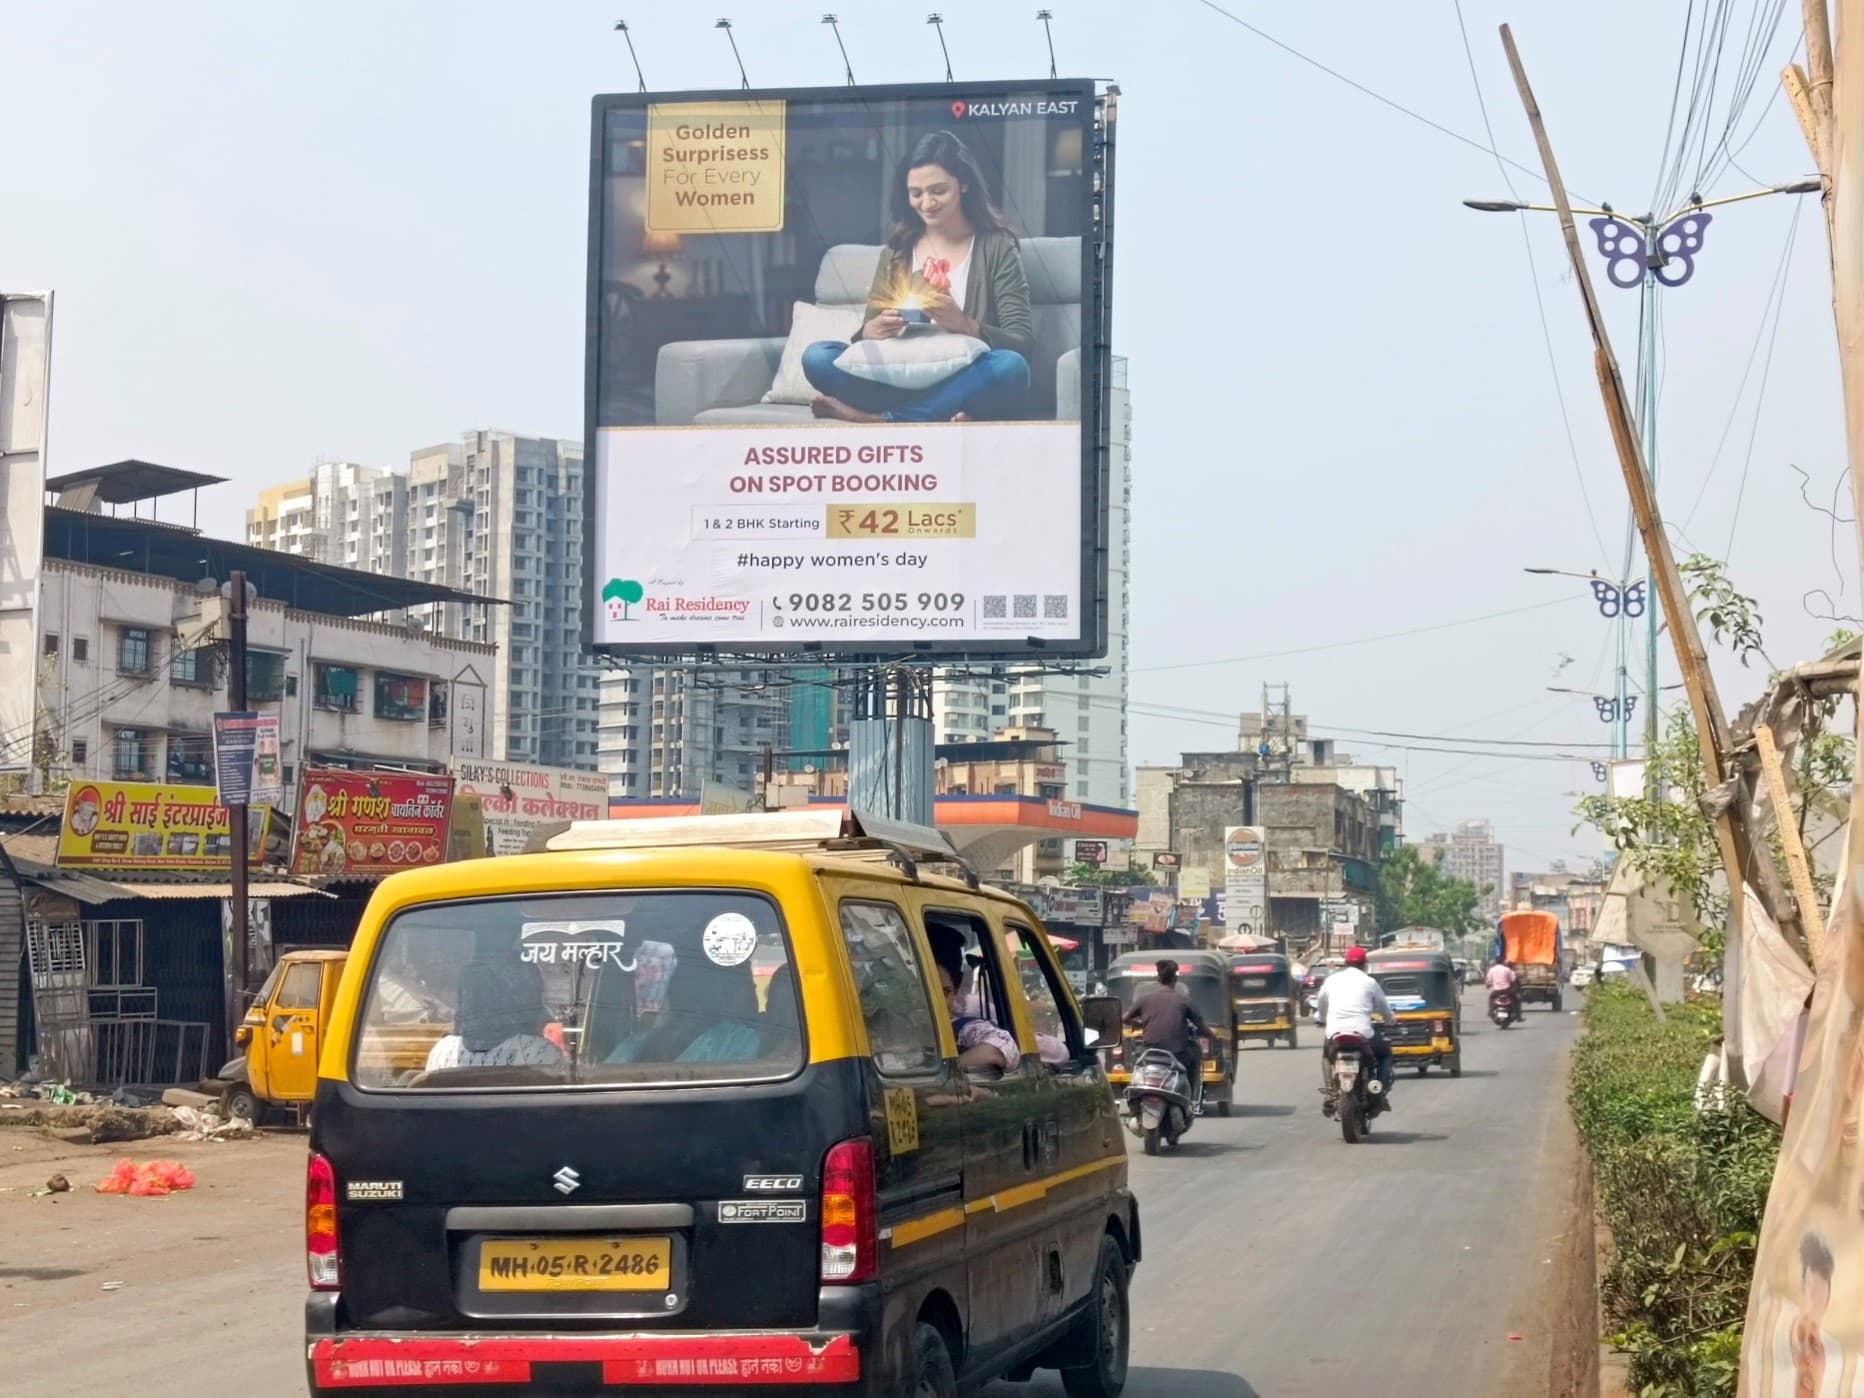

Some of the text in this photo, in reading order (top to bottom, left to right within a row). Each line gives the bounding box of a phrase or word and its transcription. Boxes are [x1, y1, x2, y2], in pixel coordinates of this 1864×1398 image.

[968, 101, 1078, 116] KALYAN EAST
[675, 123, 751, 140] Golden
[663, 145, 769, 165] Surprisess
[663, 168, 762, 186] For Every
[675, 191, 755, 206] Women
[744, 445, 924, 465] ASSURED GIFTS
[730, 474, 938, 493] ON SPOT BOOKING
[703, 519, 709, 529] 1
[712, 519, 721, 529] &
[725, 519, 733, 529] 2
[737, 518, 765, 529] BHK
[768, 518, 820, 531] Starting
[737, 552, 928, 569] #happy women's day
[646, 597, 750, 613] Rai Residency
[789, 592, 965, 611] 9082 505 909
[790, 615, 965, 630] www.rairesidency.com
[461, 764, 494, 783] SILKY'S
[496, 768, 550, 789] COLLECTIONS
[104, 790, 126, 825] श्री
[130, 792, 162, 829] साई
[328, 788, 349, 817] श्री
[522, 792, 601, 820] कलेक्शन
[520, 942, 638, 972] जय मल्हार
[348, 1182, 402, 1190] MARUTI
[745, 1178, 801, 1189] EECO
[348, 1190, 402, 1198] SUZUKI
